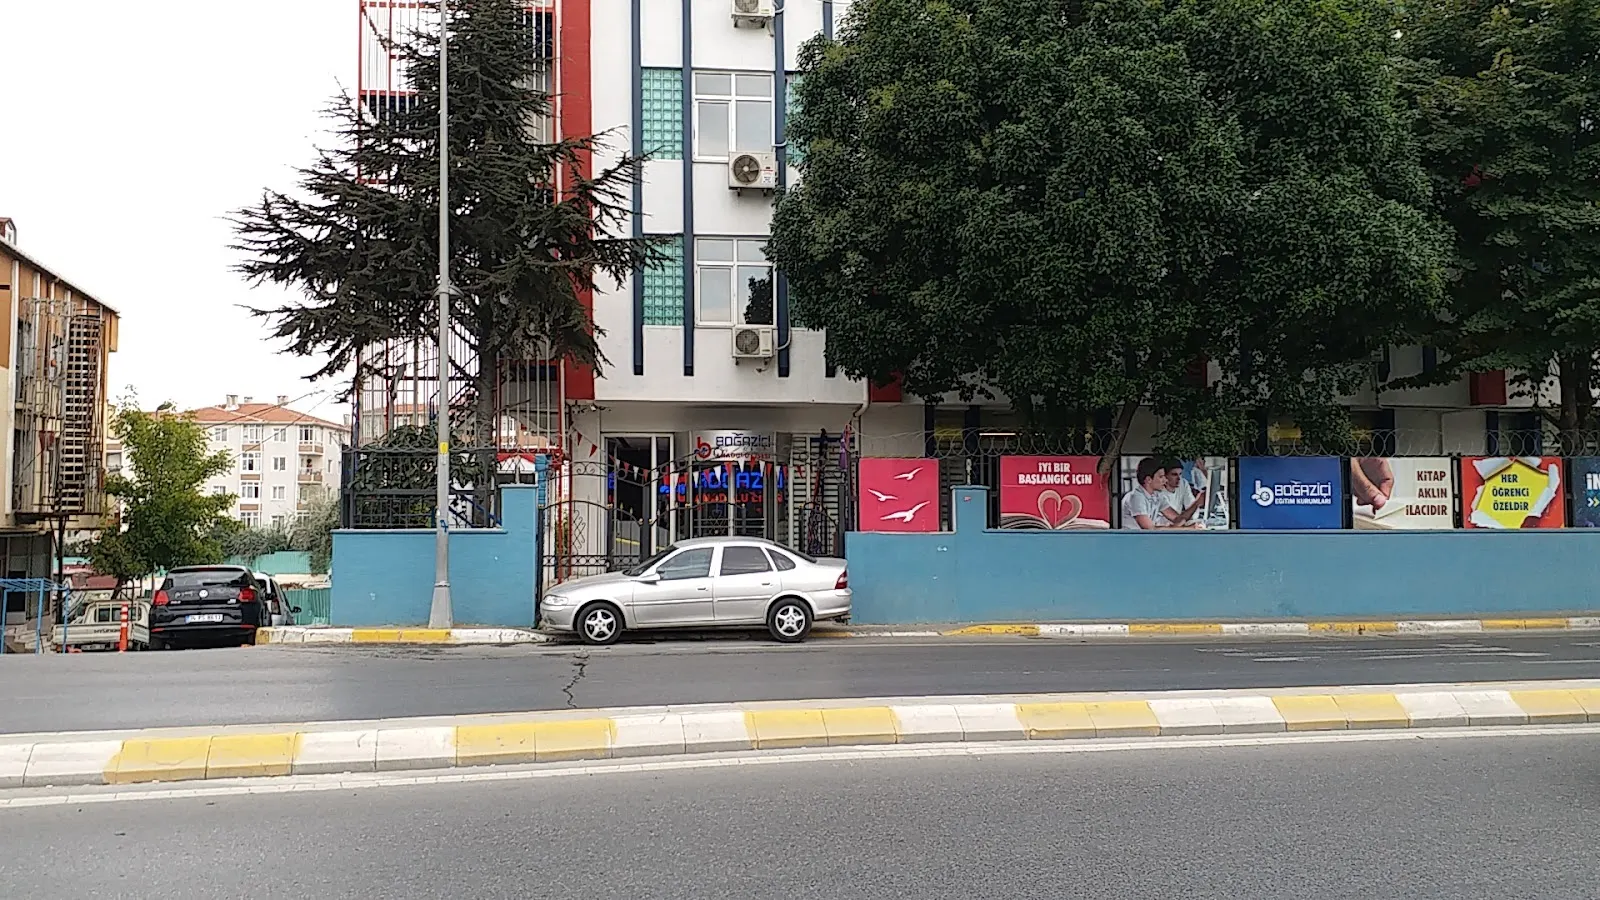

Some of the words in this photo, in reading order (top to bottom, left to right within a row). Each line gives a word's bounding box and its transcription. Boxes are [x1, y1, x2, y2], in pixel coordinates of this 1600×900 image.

[715, 432, 771, 450] BOĞAZİÇİ
[1038, 462, 1052, 472] İYİ
[1053, 462, 1071, 472] BİR
[1018, 474, 1070, 485] BAŞLANGIÇ
[1071, 474, 1093, 485] İÇİN
[1416, 471, 1446, 481] KİTAP
[1501, 474, 1518, 483] HER
[1274, 480, 1332, 498] BOĞAZİÇİ
[1418, 488, 1447, 498] AKLIN
[1492, 487, 1529, 497] ÖĞRENCİ
[1405, 505, 1448, 516] İLACIDIR
[1493, 501, 1529, 511] ÖZELDİR
